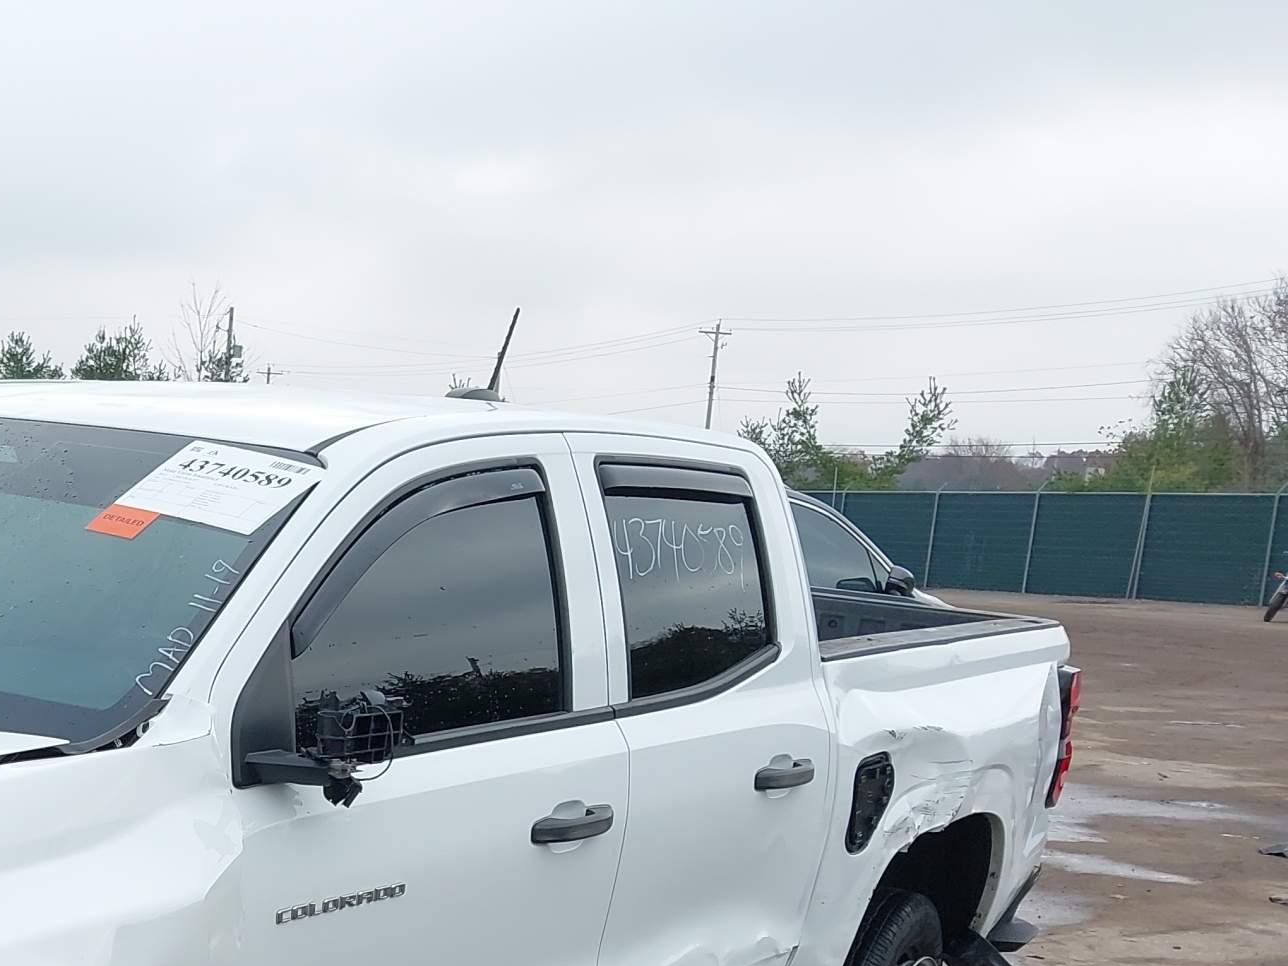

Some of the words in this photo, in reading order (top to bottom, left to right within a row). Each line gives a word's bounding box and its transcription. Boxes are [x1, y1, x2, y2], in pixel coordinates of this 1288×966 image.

[178, 457, 293, 490] 43740589
[102, 512, 146, 527] DETAILED
[135, 626, 194, 696] MAD
[187, 559, 240, 614] 11-19
[275, 882, 406, 925] COLORADO
